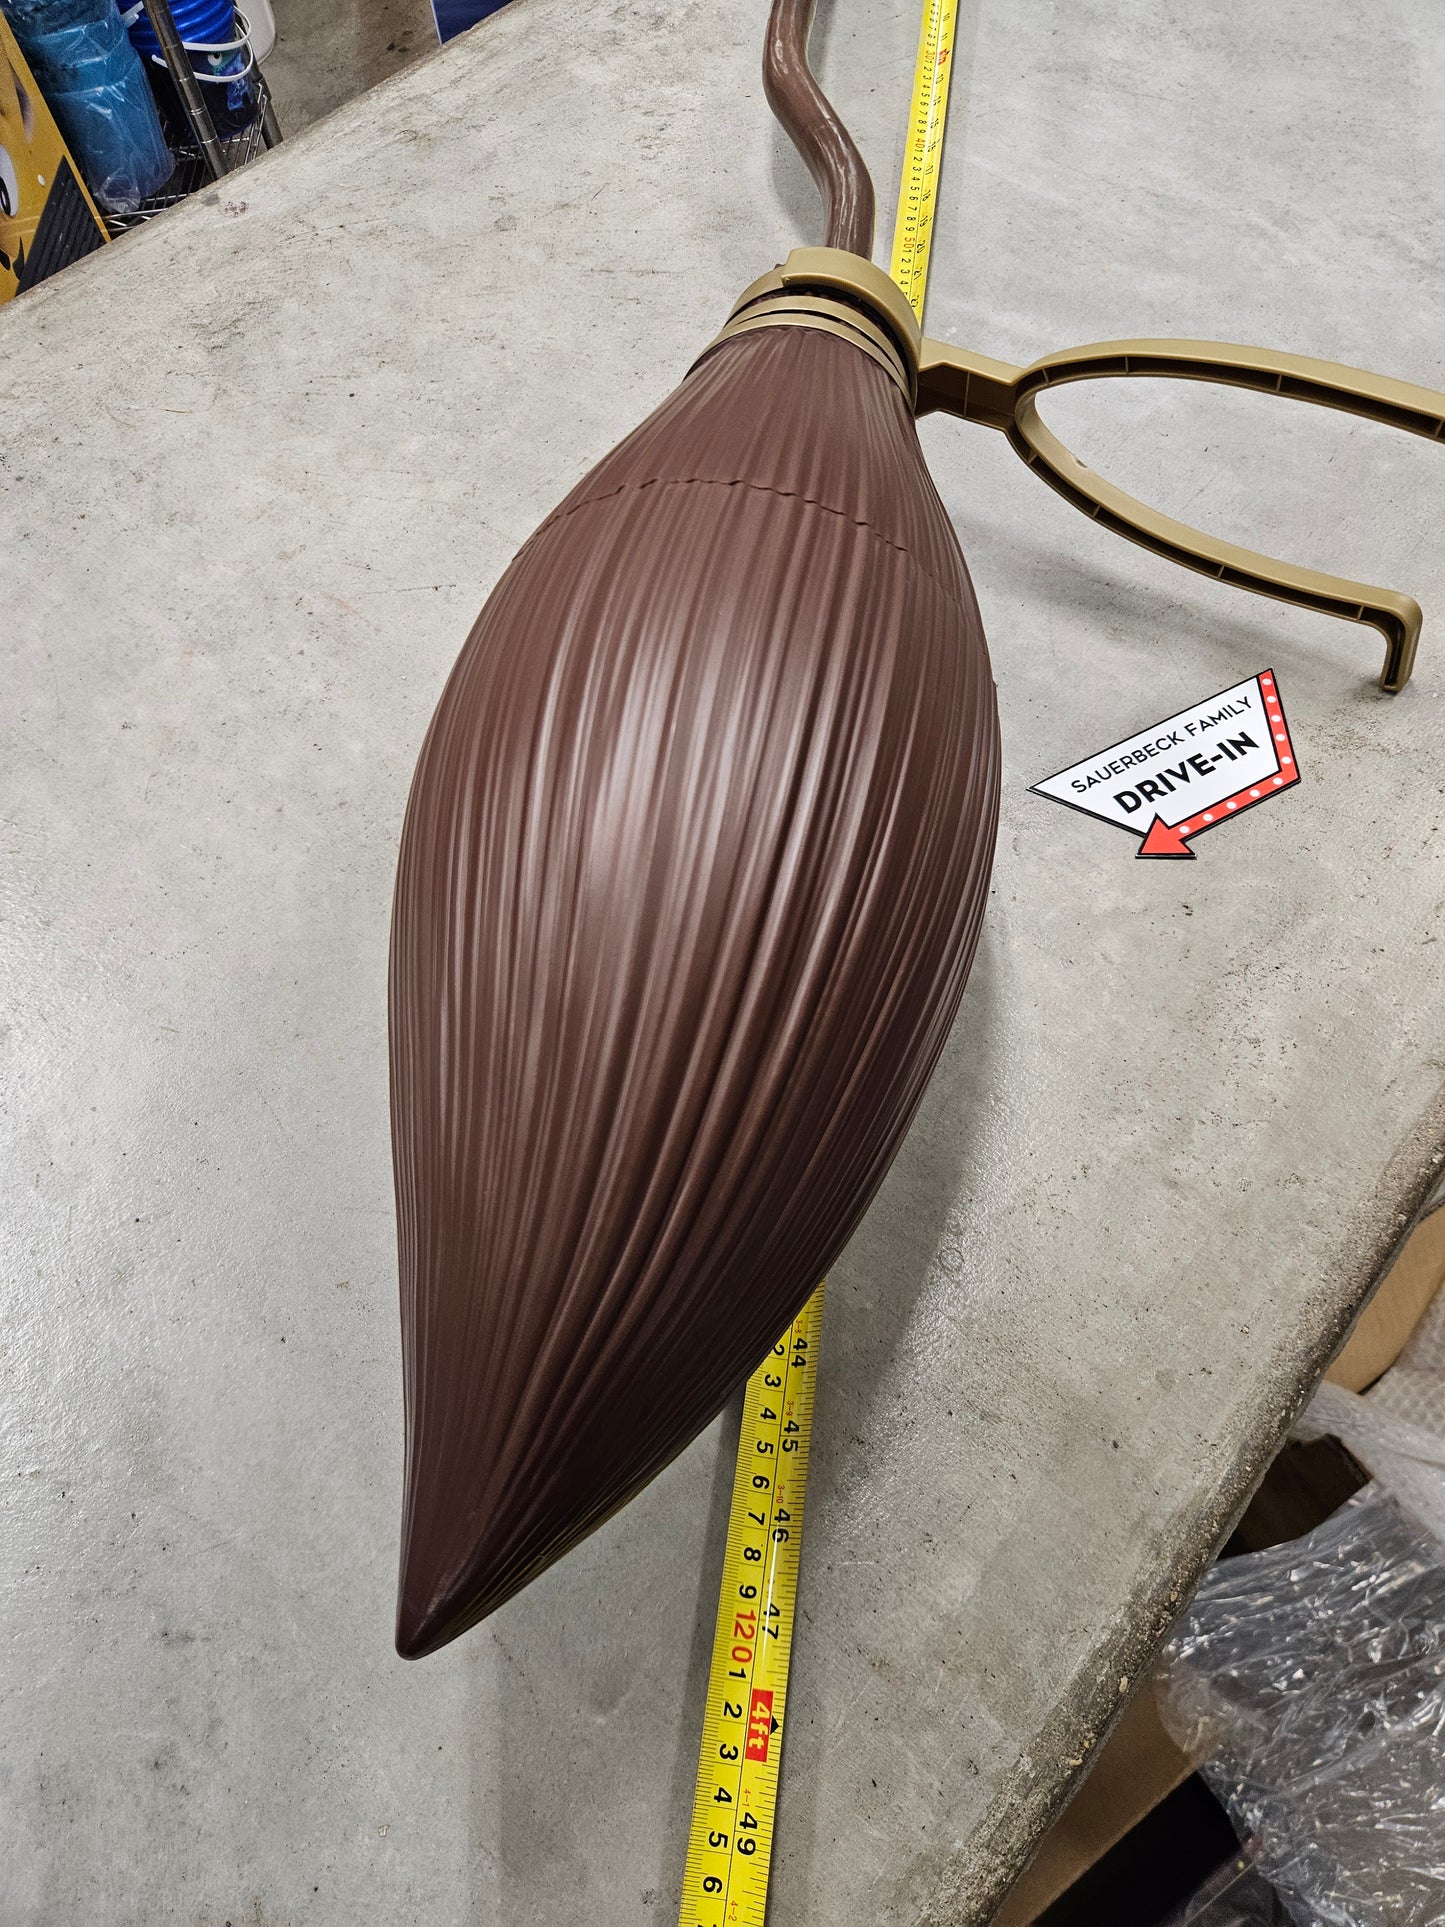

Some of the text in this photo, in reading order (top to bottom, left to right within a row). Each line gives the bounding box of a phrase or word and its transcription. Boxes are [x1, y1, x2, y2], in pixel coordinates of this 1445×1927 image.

[915, 138, 925, 148] 40
[904, 237, 915, 248] 50
[917, 240, 926, 254] 20
[1071, 696, 1252, 793] SAUERBECK FAMILY
[1112, 732, 1260, 814] DRIVE-IN
[791, 1338, 808, 1368] 44
[765, 1374, 781, 1388] 3
[760, 1407, 776, 1420] 4
[782, 1420, 799, 1452] 45
[757, 1440, 774, 1454] 5
[752, 1475, 770, 1489] 6
[748, 1512, 765, 1526] 7
[772, 1509, 790, 1542] 46
[744, 1547, 761, 1561] 8
[739, 1584, 757, 1599] 9
[762, 1603, 780, 1640] 47
[732, 1609, 756, 1663] 120
[729, 1668, 746, 1679] 1
[724, 1701, 742, 1718] 2
[749, 1702, 770, 1750] 4ft
[720, 1744, 738, 1761] 3
[714, 1787, 732, 1803] 4
[708, 1831, 728, 1848] 5
[737, 1812, 758, 1856] 49
[703, 1876, 722, 1893] 6
